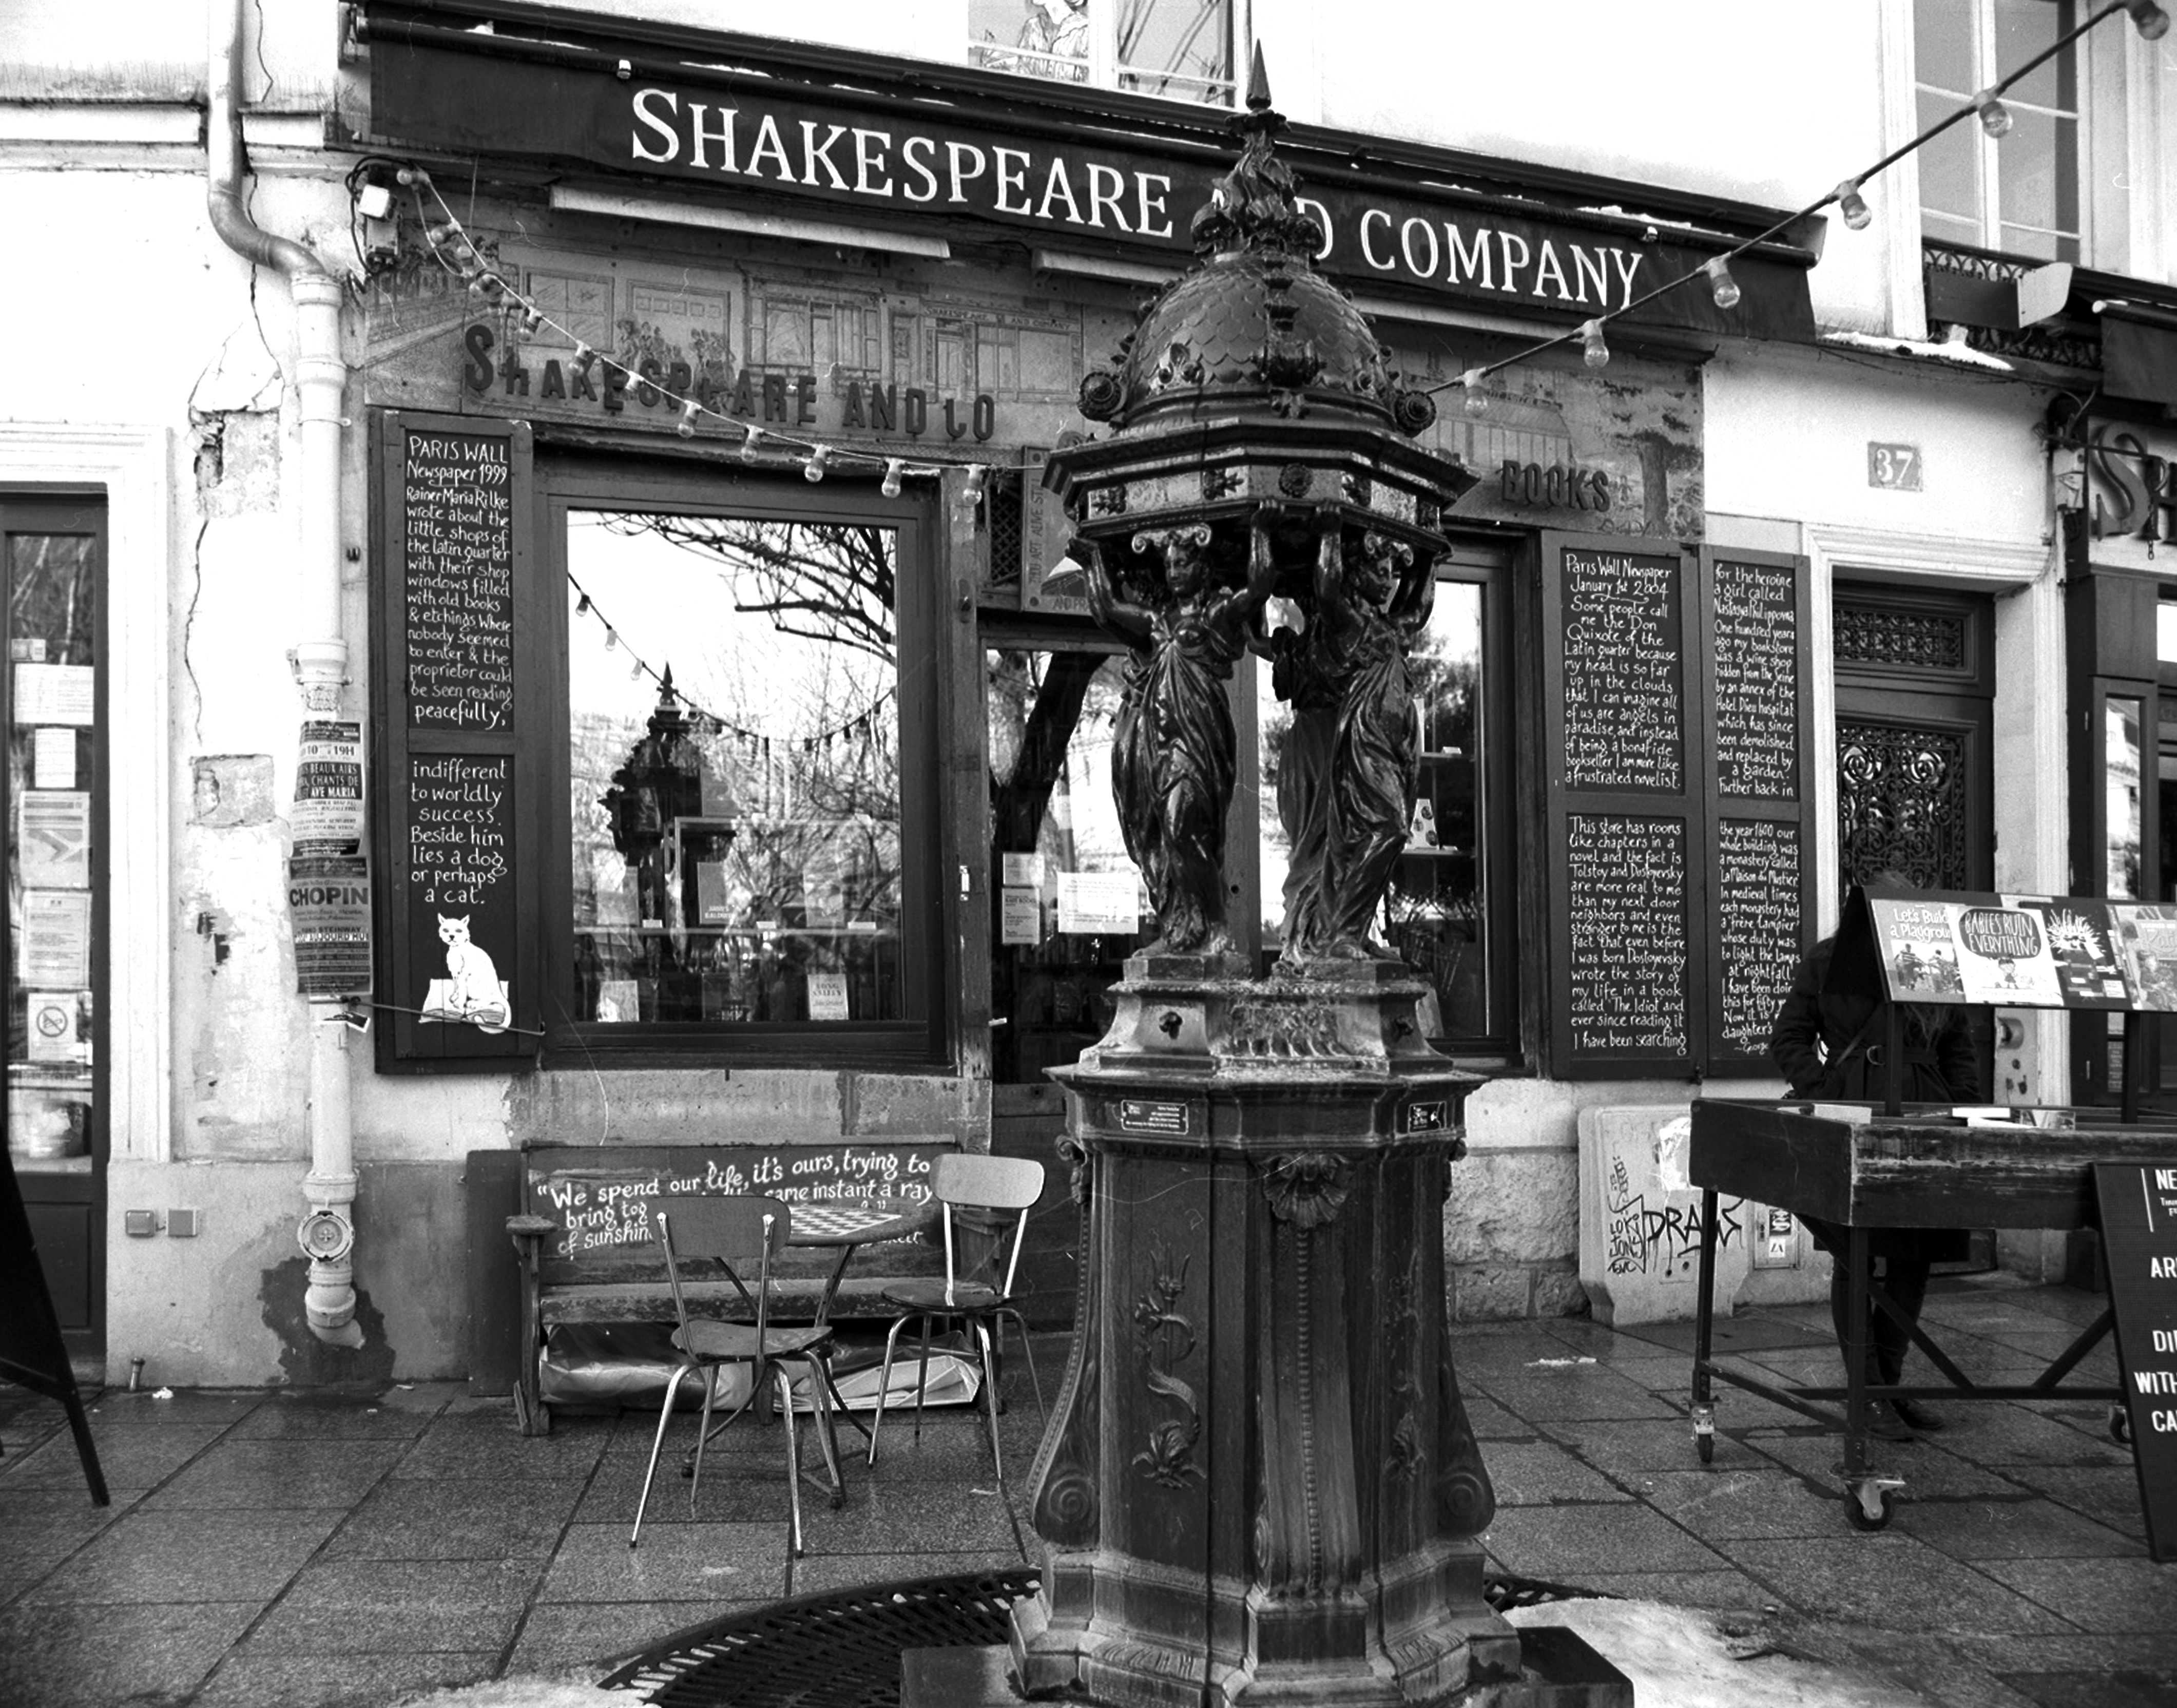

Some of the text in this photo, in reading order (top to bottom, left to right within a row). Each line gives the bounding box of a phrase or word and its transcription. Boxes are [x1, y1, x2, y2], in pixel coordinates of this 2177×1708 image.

[632, 88, 1174, 239] SHAKESPEARE
[1360, 209, 1643, 310] COMPANY
[842, 382, 927, 435] AND
[410, 436, 508, 463] PARIS WALL
[407, 459, 507, 487] Newspaper 1999
[1876, 448, 1915, 485] 37
[407, 486, 509, 510] Rainer Maria Rilke
[1502, 459, 1611, 513] BOOKS
[407, 504, 509, 528] wrote about the
[408, 521, 508, 550] little shops of
[408, 538, 510, 564] the latin quarter
[409, 555, 509, 585] with their shop
[1566, 553, 1596, 575] Paris
[1597, 555, 1620, 576] Wall
[408, 573, 510, 598] windows filled
[1570, 574, 1613, 602] January
[1632, 581, 1669, 601] 2004
[408, 589, 500, 612] with old books
[1571, 594, 1668, 619] Some people call
[409, 606, 419, 623] &
[479, 613, 511, 632] Where
[1581, 613, 1656, 630] me the Don
[408, 624, 510, 649] nobody seemed
[1567, 623, 1664, 646] Quixote of the
[409, 643, 510, 666] to enter & the
[410, 662, 512, 684] proprietor could
[411, 680, 512, 711] be seen reading
[1718, 713, 1794, 733] which has since
[311, 776, 358, 786] CHANTS DE
[413, 758, 507, 783] indifferent
[1732, 764, 1739, 776] a
[328, 787, 356, 798] MARIA
[411, 782, 502, 810] to worldly
[1719, 777, 1794, 797] Further back in
[411, 824, 504, 846] Beside him
[1569, 816, 1681, 835] This store has rooms
[1569, 833, 1674, 852] like chapters in a
[413, 845, 507, 877] lies a dog
[411, 866, 496, 889] or perhaps
[290, 887, 369, 907] CHOPIN
[425, 888, 435, 903] a
[1572, 893, 1680, 911] than my next door
[1894, 908, 1919, 923] Let's
[1964, 912, 2002, 935] BABIES
[2003, 913, 2033, 937] RUIN
[1890, 925, 1899, 938] a
[1722, 945, 1801, 969] to light the lamps
[1969, 933, 2038, 957] EVERYTHING
[1574, 1026, 1687, 1056] I have been searching
[597, 1178, 660, 1205] spend
[670, 1179, 701, 1193] our
[753, 1157, 784, 1184] it's
[842, 1149, 898, 1180] trying
[908, 1154, 931, 1174] to
[566, 1205, 617, 1231] bring
[813, 1180, 876, 1199] instant
[880, 1182, 892, 1198] a
[901, 1183, 934, 1207] ray
[557, 1220, 653, 1254] of sunshin
[2150, 1257, 2177, 1279] AR
[2152, 1330, 2177, 1353] DI
